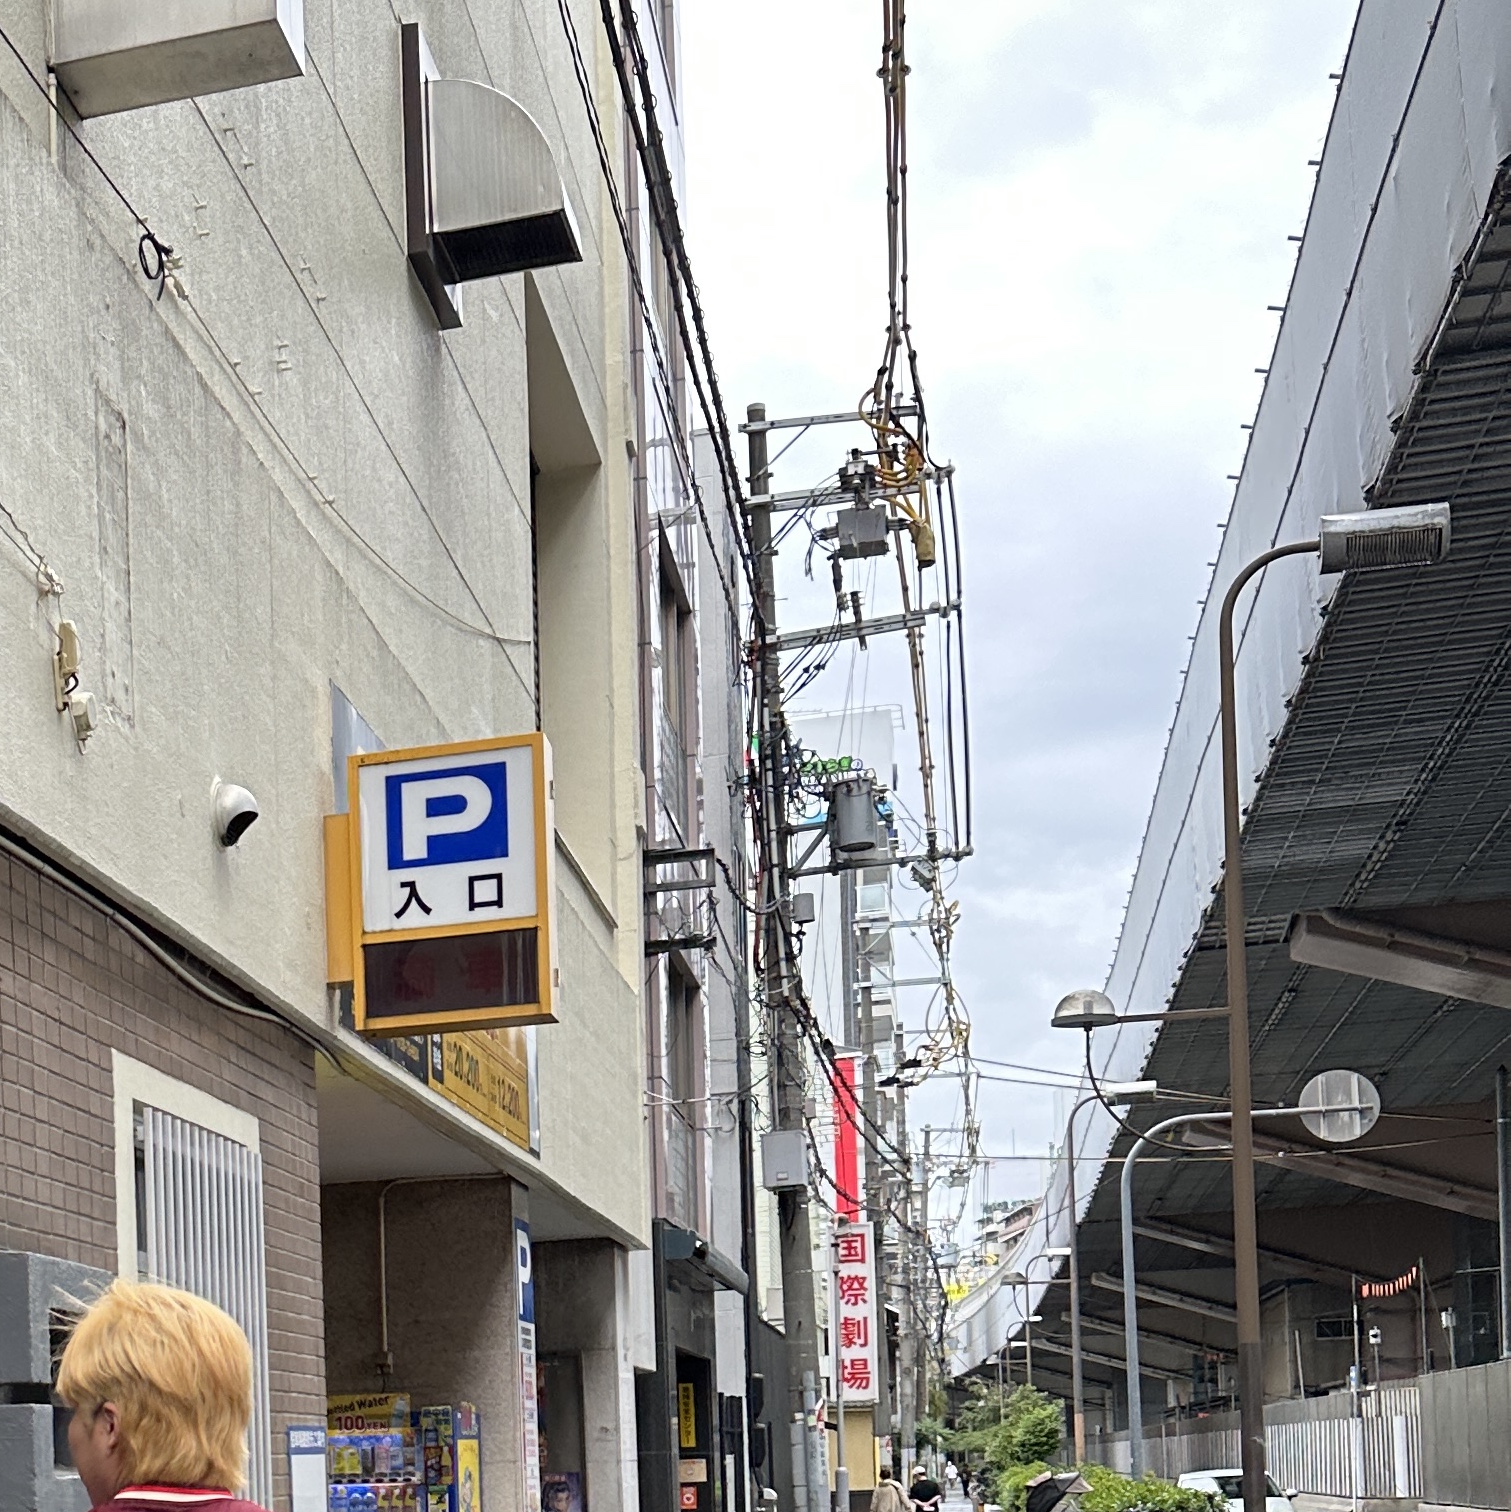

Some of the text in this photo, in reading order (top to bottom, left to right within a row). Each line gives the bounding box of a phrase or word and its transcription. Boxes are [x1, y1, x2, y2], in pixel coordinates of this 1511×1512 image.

[401, 775, 492, 861] P
[394, 872, 504, 919] 入口
[517, 1228, 532, 1315] P
[838, 1233, 872, 1390] 国際劇場
[335, 1415, 366, 1431] 100
[357, 1395, 390, 1410] Water
